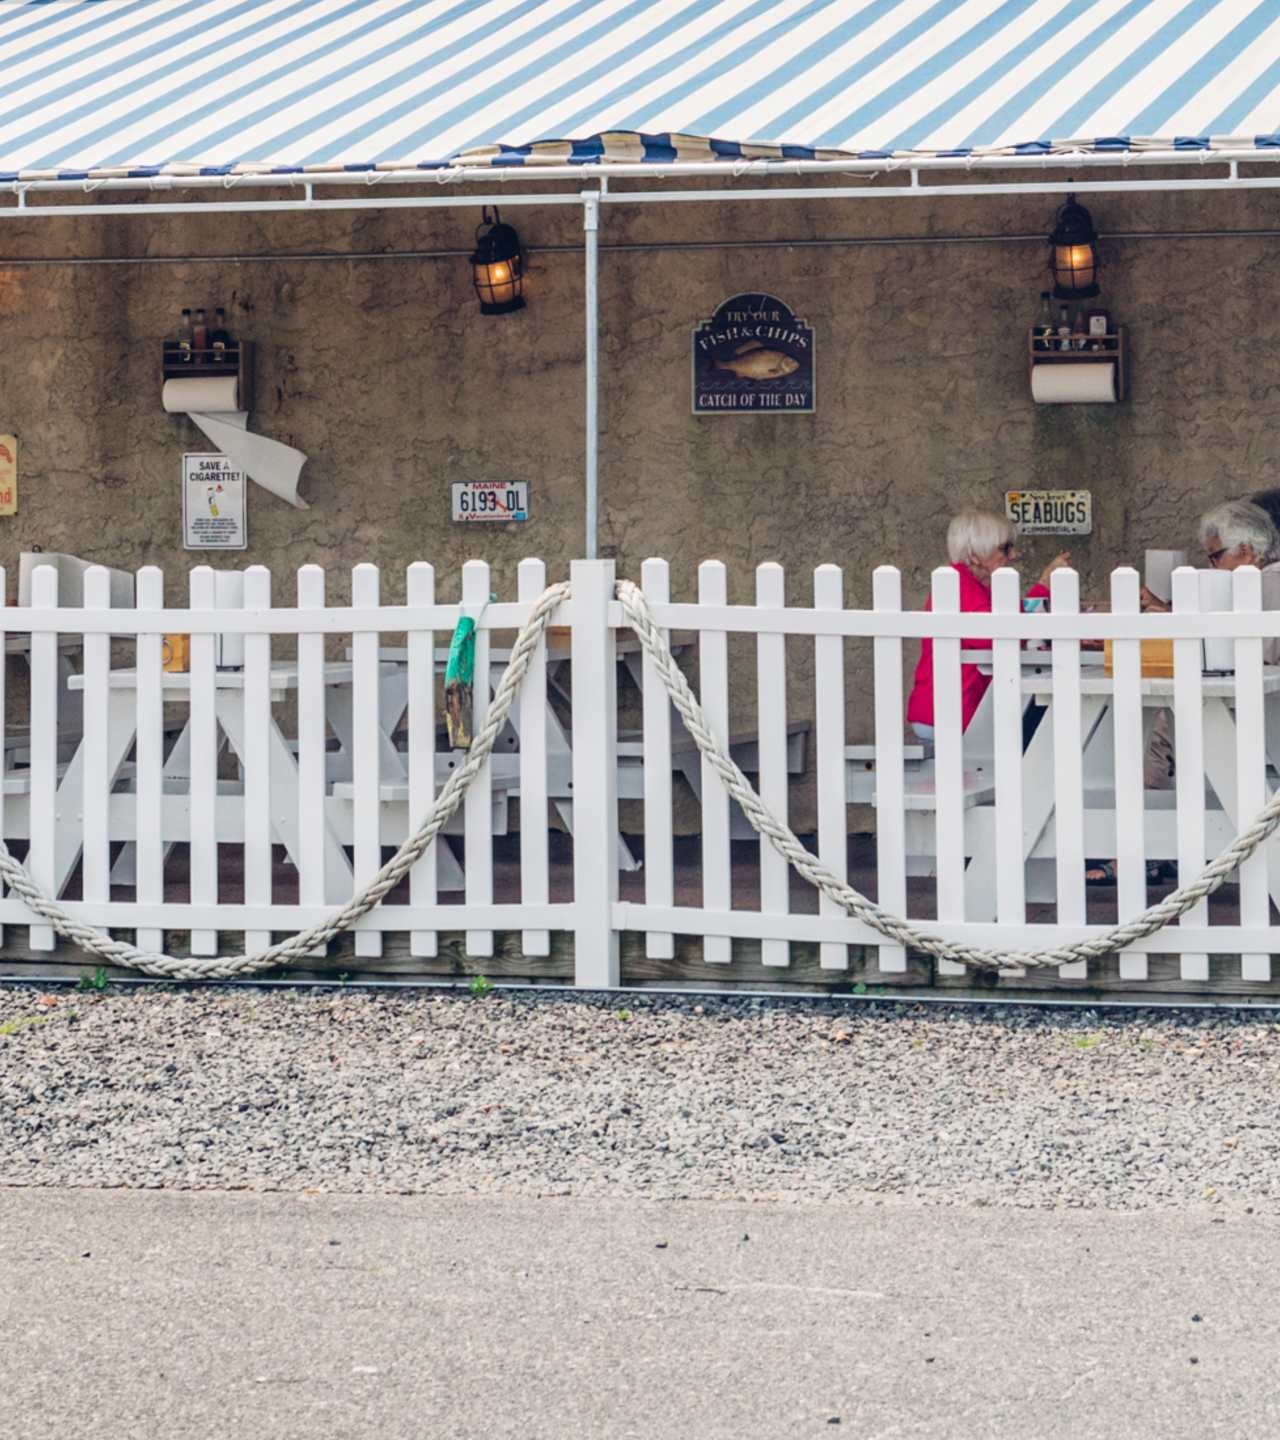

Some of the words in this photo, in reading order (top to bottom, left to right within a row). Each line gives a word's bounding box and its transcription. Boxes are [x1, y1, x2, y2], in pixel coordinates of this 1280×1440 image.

[726, 311, 747, 322] TRY
[754, 310, 780, 321] OUR
[699, 326, 739, 350] FISH
[755, 325, 809, 348] CHIPS
[699, 394, 737, 407] CATCH
[740, 394, 756, 407] OF
[758, 393, 782, 407] THE
[785, 393, 807, 407] DAY
[199, 461, 221, 471] SAVE
[472, 481, 507, 490] MAINE
[460, 490, 497, 512] 6193
[1010, 501, 1086, 524] SEABUGS
